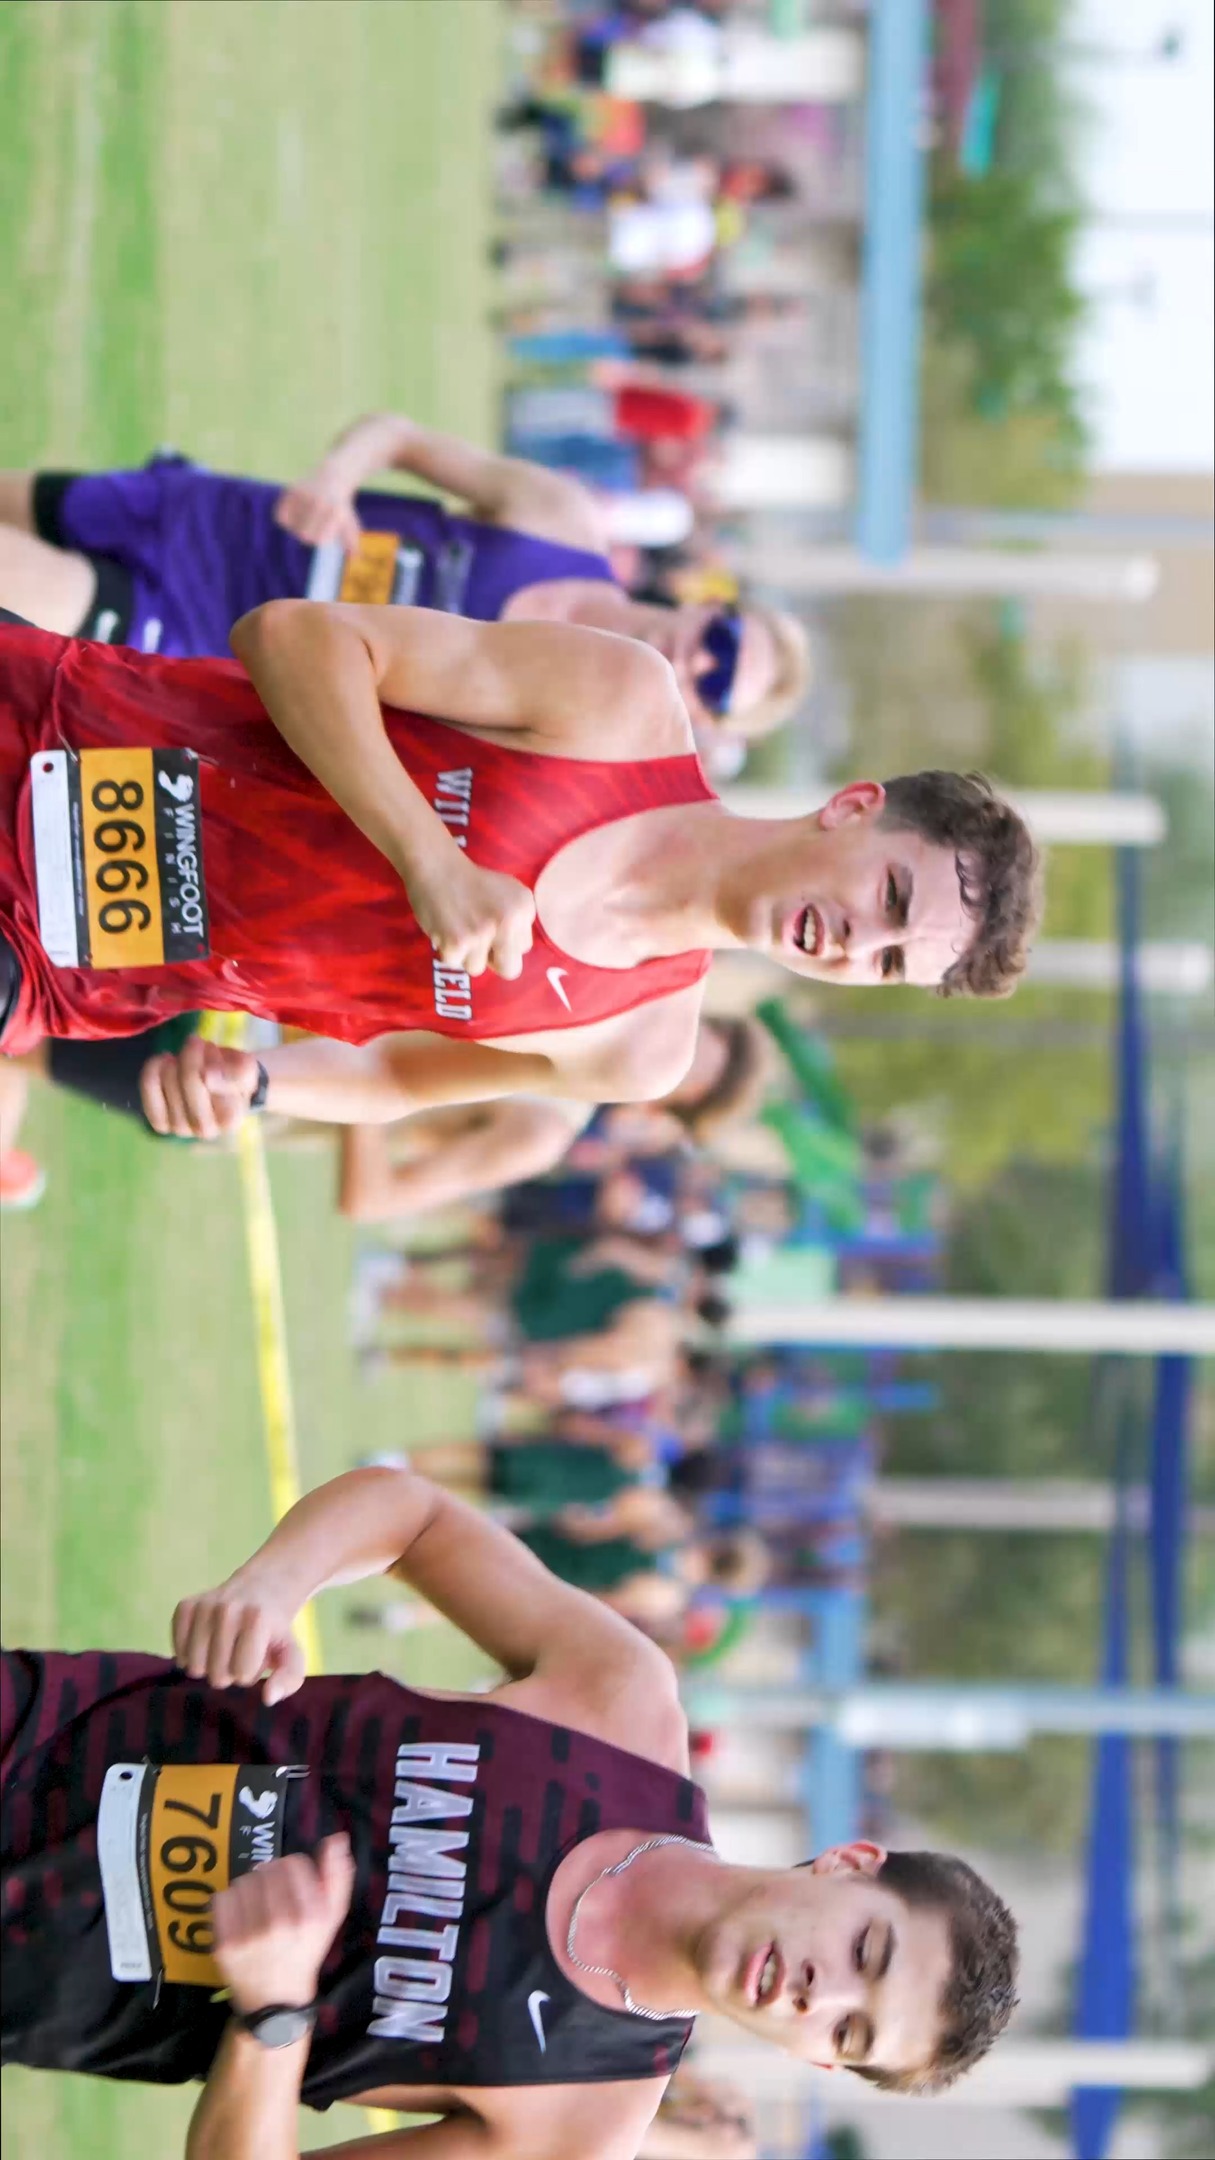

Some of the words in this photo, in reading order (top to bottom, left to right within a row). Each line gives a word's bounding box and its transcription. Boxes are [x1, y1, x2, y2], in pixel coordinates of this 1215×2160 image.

[91, 778, 152, 934] 8666
[163, 807, 181, 934] FINISH
[174, 802, 204, 938] WINGFOOT
[160, 1793, 222, 1956] 7609
[250, 1820, 276, 1871] WIN
[366, 1741, 481, 2043] HAMILTON
